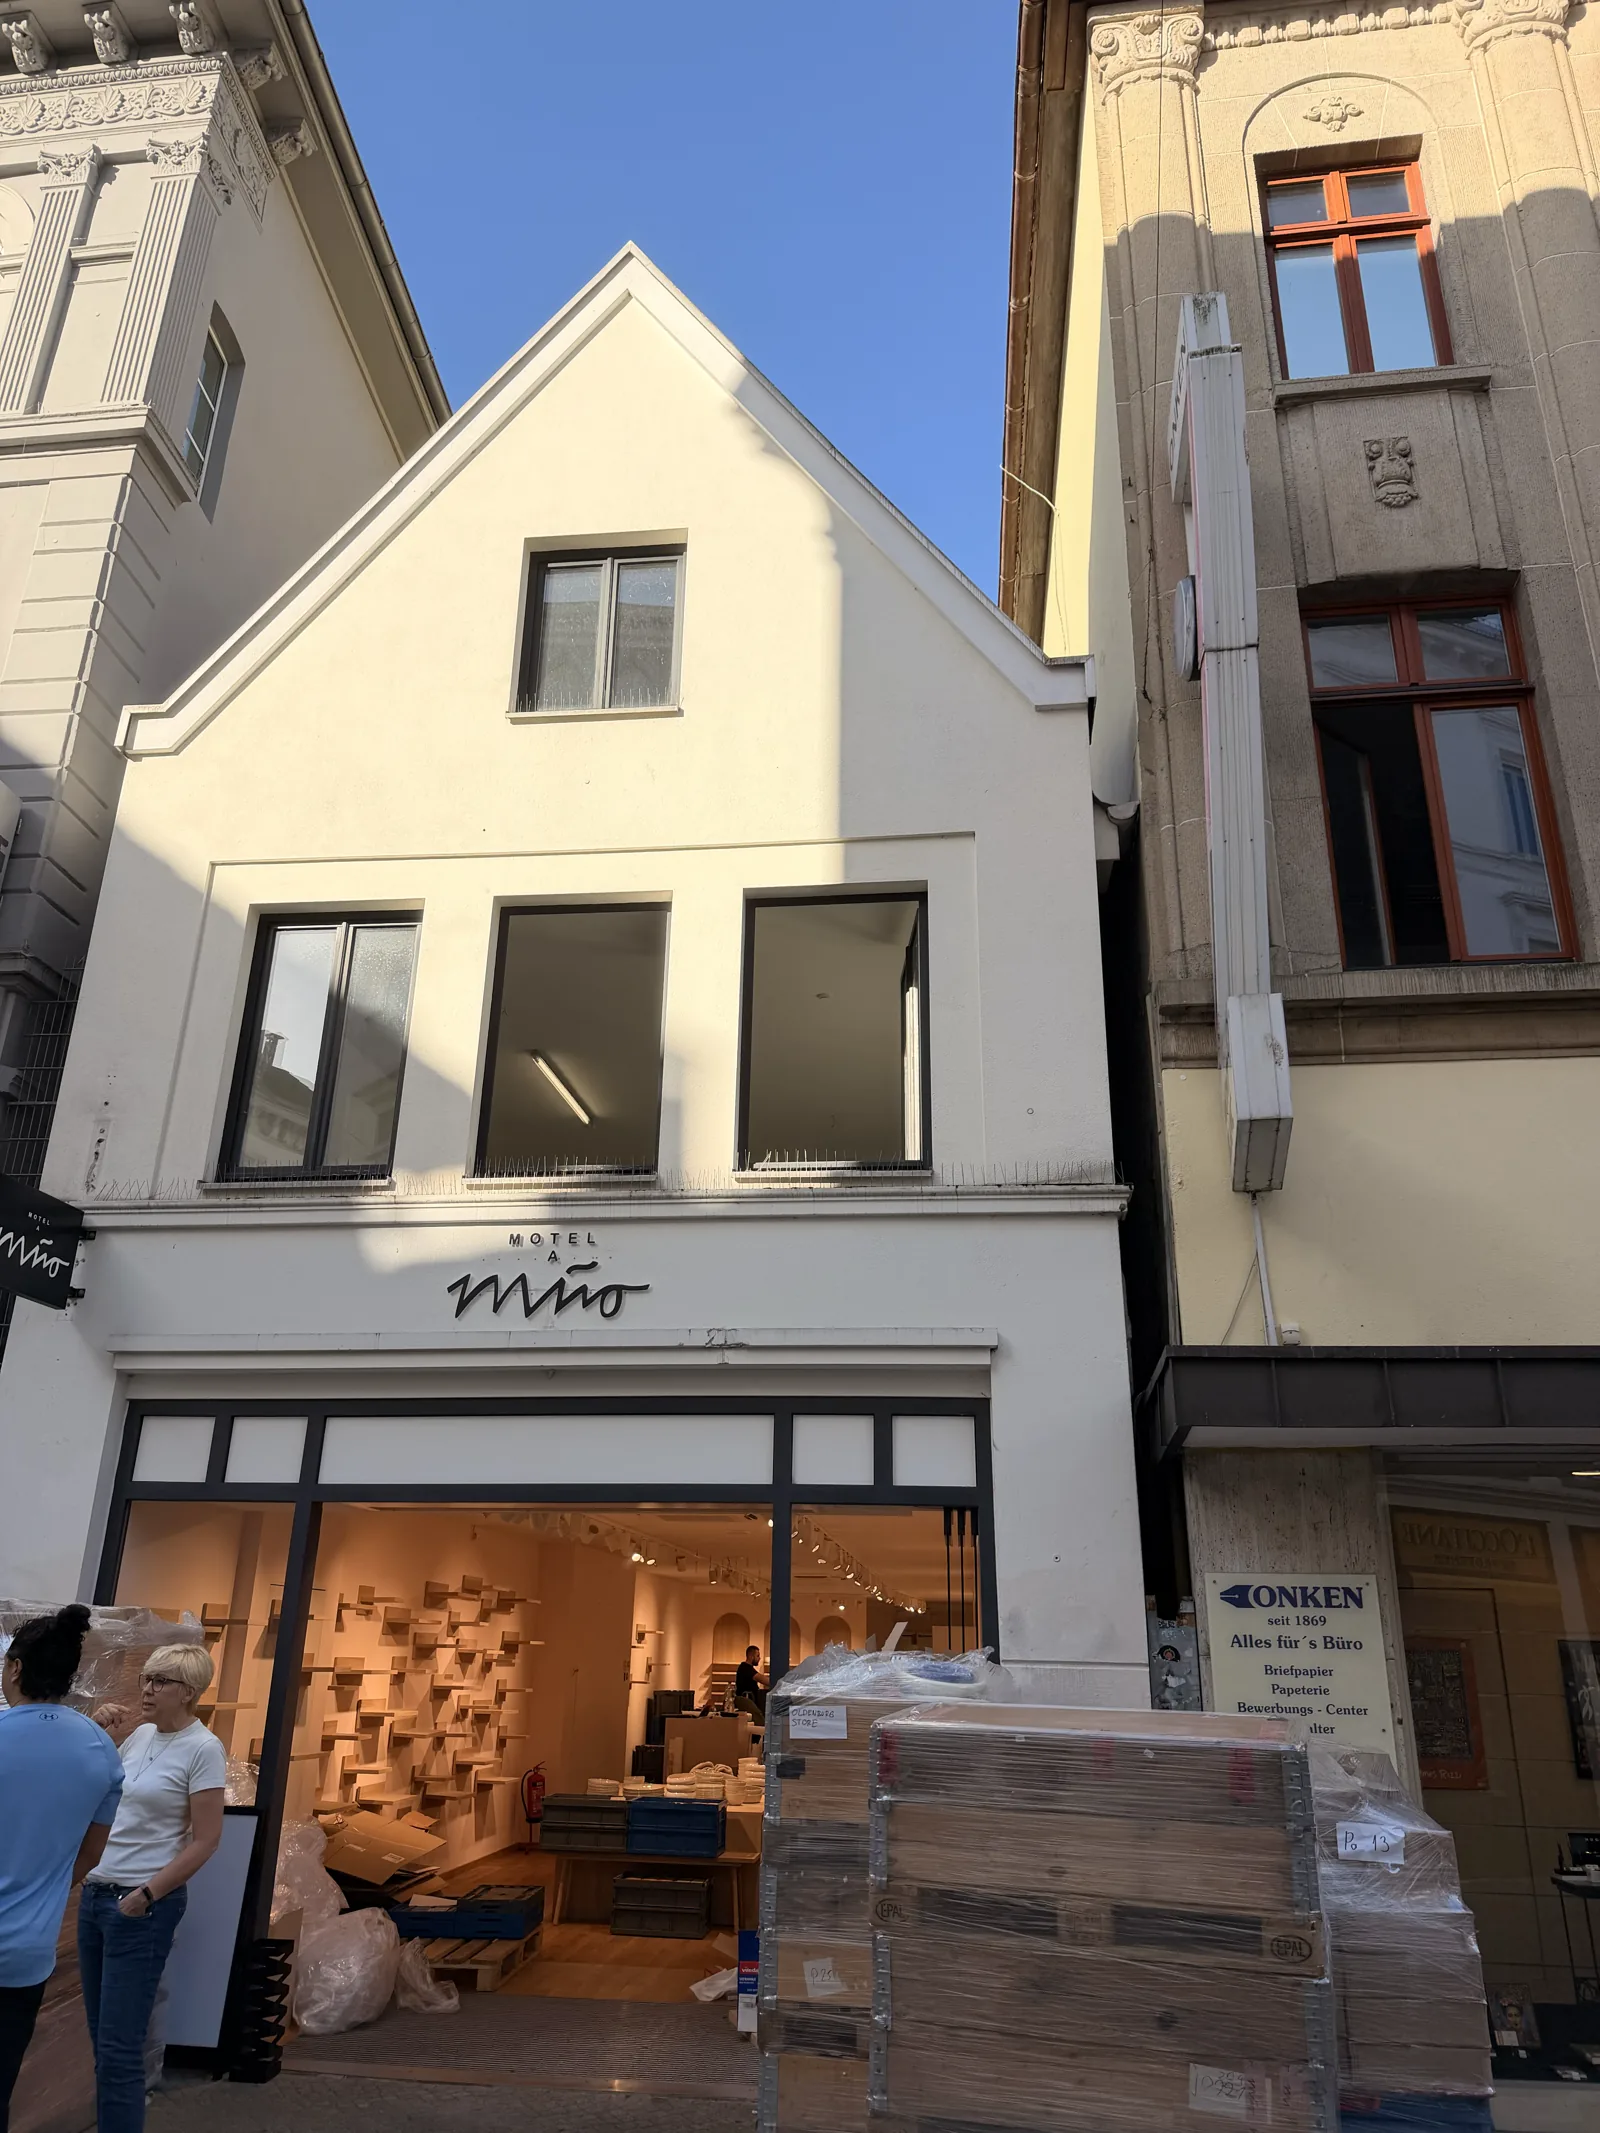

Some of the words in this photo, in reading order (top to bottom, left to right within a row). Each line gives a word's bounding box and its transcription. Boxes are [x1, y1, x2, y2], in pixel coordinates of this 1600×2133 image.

[28, 1211, 50, 1226] MOTEL
[509, 1232, 596, 1245] MOTEL
[547, 1250, 559, 1262] A
[1252, 1585, 1364, 1609] ONKEN
[1267, 1616, 1291, 1626] seit
[1295, 1615, 1327, 1627] 1869
[1230, 1634, 1272, 1649] Alles
[1323, 1635, 1364, 1650] Büro
[1264, 1664, 1334, 1679] Briefpapier
[1271, 1683, 1330, 1697] Papeterie
[1237, 1702, 1314, 1716] Bewerbungs
[1326, 1703, 1368, 1716] Center
[791, 1719, 818, 1728] STORE
[1372, 1835, 1390, 1852] 13
[1277, 1940, 1306, 1958] EPAL
